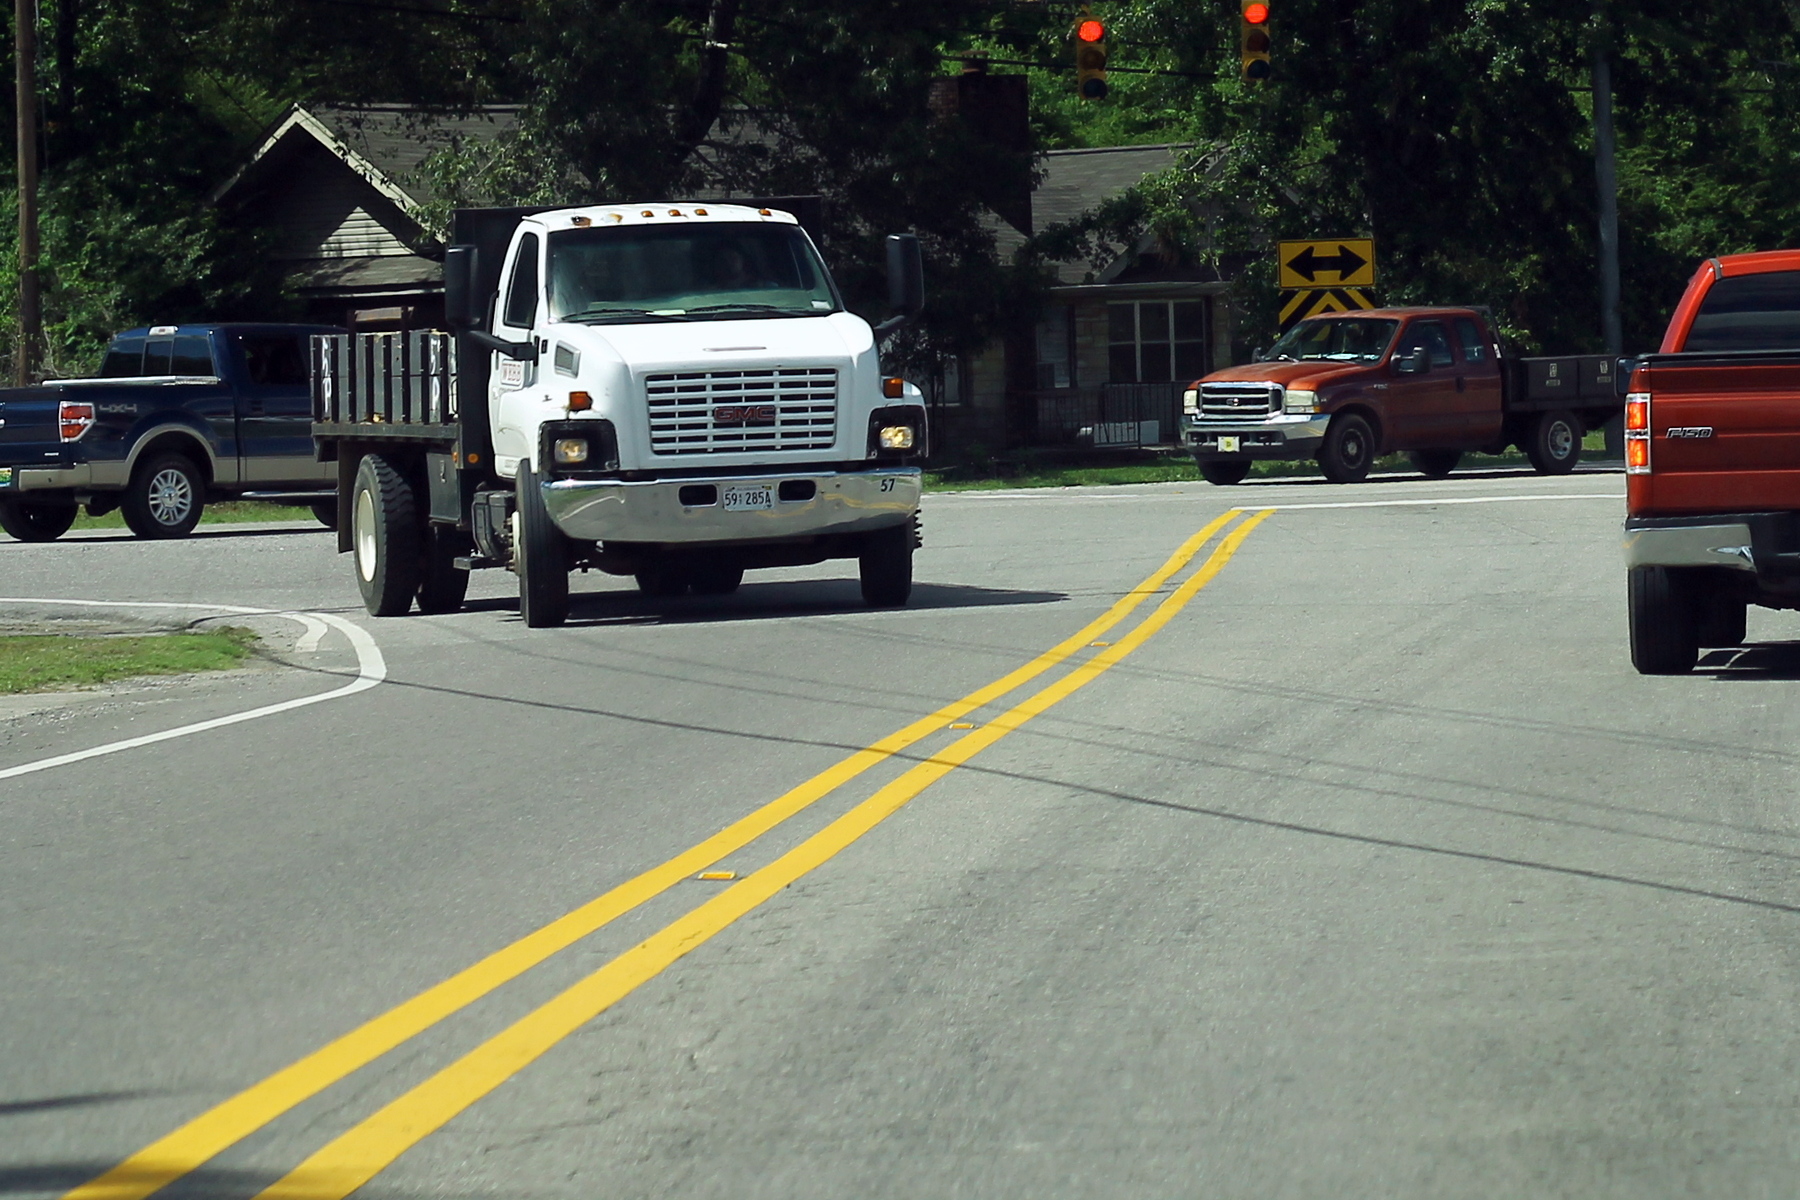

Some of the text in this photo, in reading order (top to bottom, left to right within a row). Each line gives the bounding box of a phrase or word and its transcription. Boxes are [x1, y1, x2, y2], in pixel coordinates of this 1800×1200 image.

[715, 406, 775, 421] GMC
[880, 479, 895, 493] 57
[725, 491, 771, 506] 59 285A
